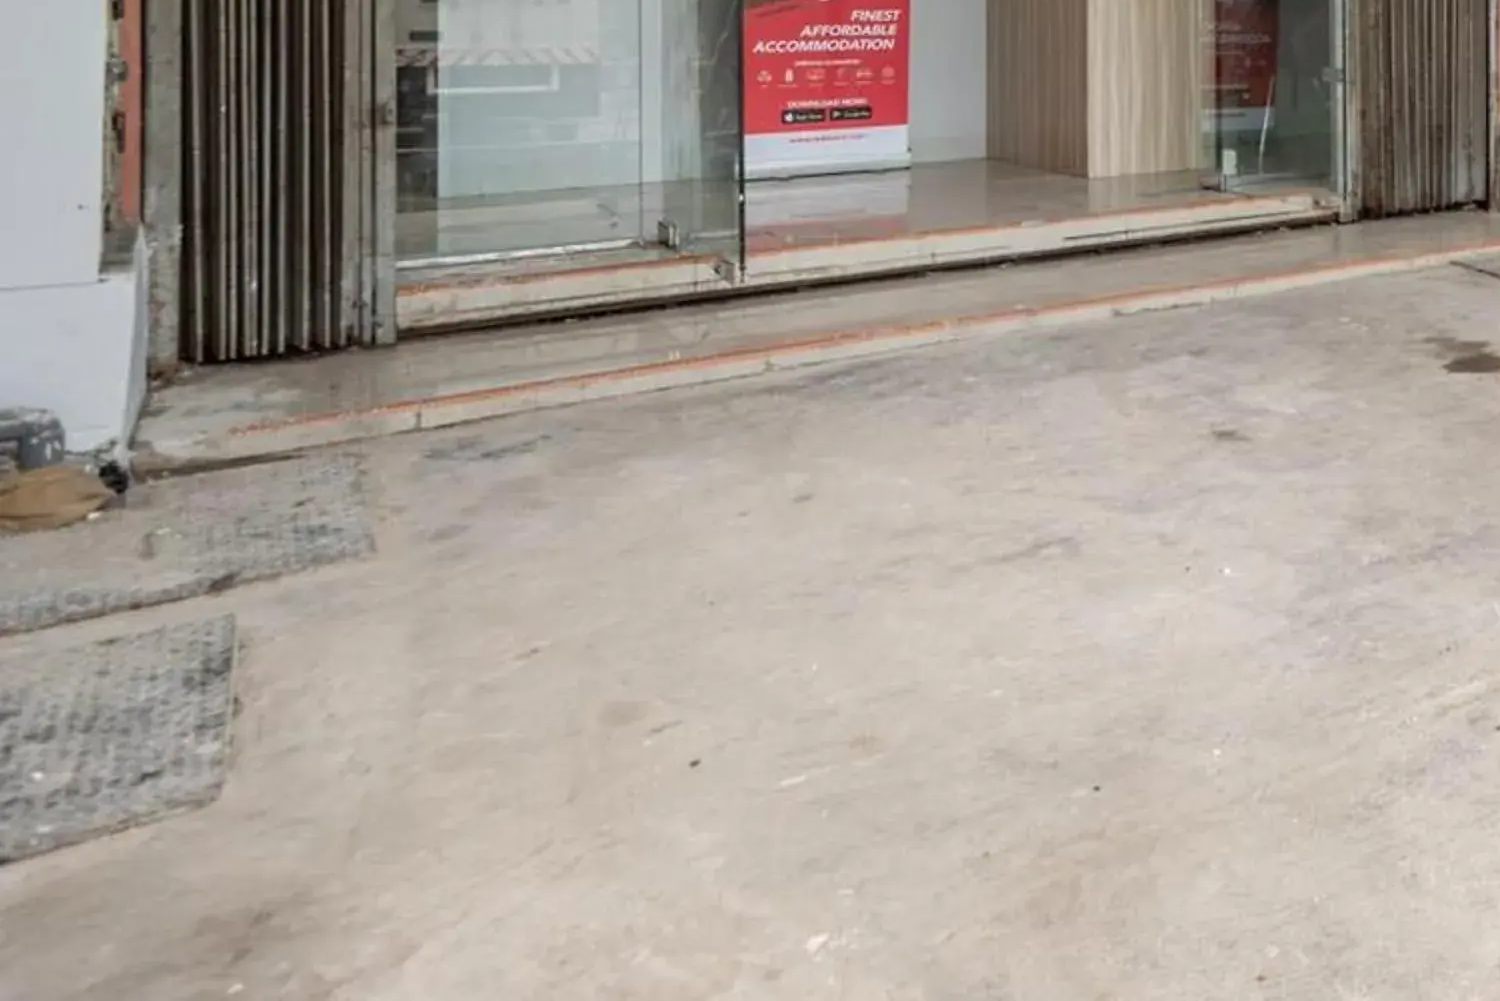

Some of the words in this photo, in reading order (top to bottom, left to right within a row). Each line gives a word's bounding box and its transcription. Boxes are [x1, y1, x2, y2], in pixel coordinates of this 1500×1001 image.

[851, 9, 901, 22] FINEST
[800, 24, 897, 37] AFFORDABLE
[753, 38, 894, 53] ACCOMMODATION
